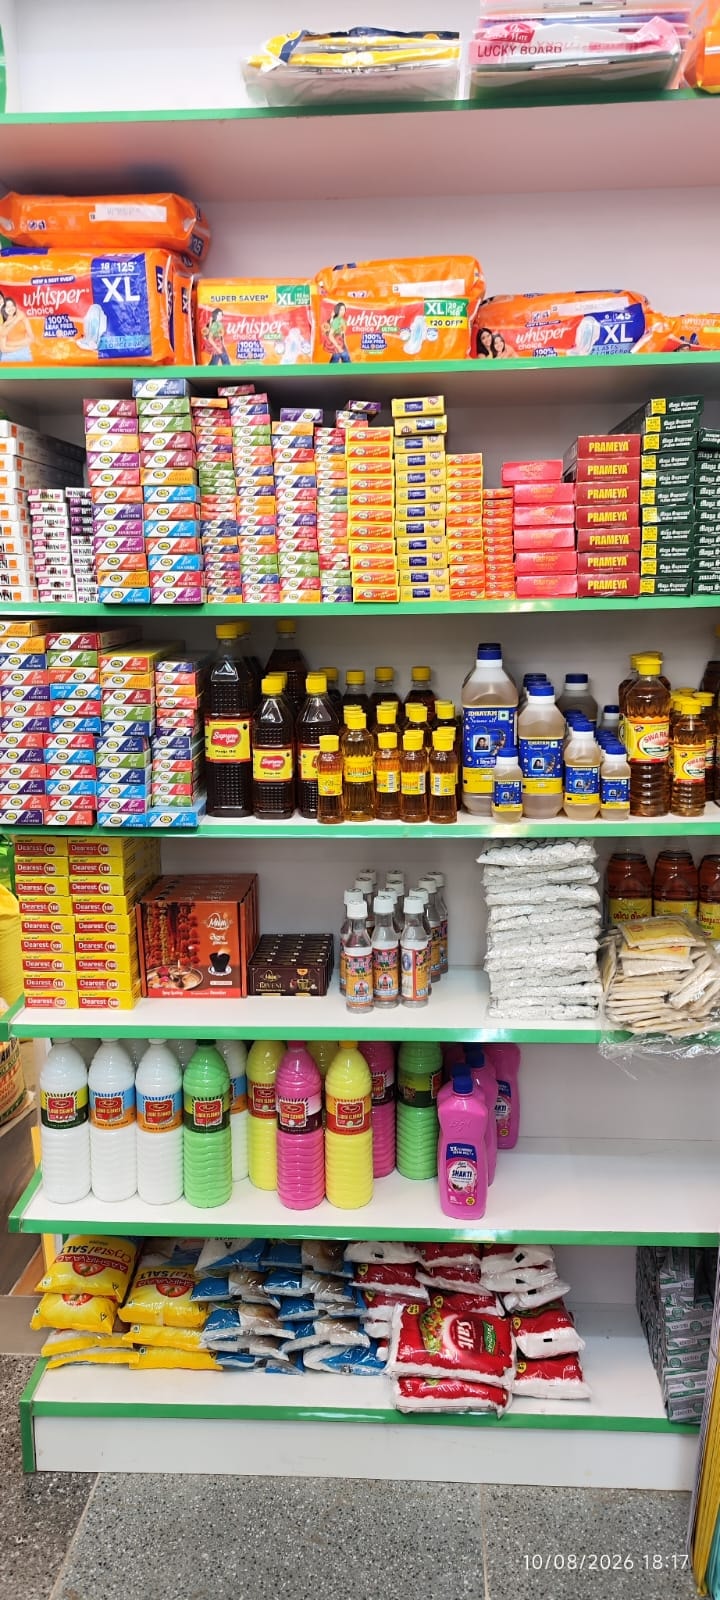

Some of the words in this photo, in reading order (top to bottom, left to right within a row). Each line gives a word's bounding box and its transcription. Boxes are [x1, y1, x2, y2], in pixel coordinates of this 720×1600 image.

[478, 44, 517, 57] LUCKY
[520, 46, 561, 54] BOARD
[101, 276, 140, 303] XL
[23, 285, 85, 310] whisper
[278, 293, 295, 305] XL
[27, 306, 53, 316] choice
[426, 302, 444, 315] XL
[347, 311, 401, 330] whisper
[227, 317, 285, 338] whisper
[516, 327, 568, 345] whisper
[604, 324, 633, 344] XL
[589, 441, 629, 452] PRAMEYA
[587, 465, 627, 475] PRAMEYA
[587, 488, 627, 499] PRAMEYA
[587, 511, 627, 522] PRAMEYA
[589, 535, 629, 545] PRAMEYA
[587, 557, 627, 567] PRAMEYA
[587, 579, 627, 590] PRAMEYA
[452, 1170, 473, 1178] SHAKTI
[62, 1245, 89, 1254] SALT
[90, 1246, 131, 1263] Crystal
[56, 1254, 128, 1271] AASHIRVAAD
[138, 1270, 168, 1279] SALT
[136, 1278, 195, 1288] SHIRVAAD
[456, 1319, 474, 1350] Salt
